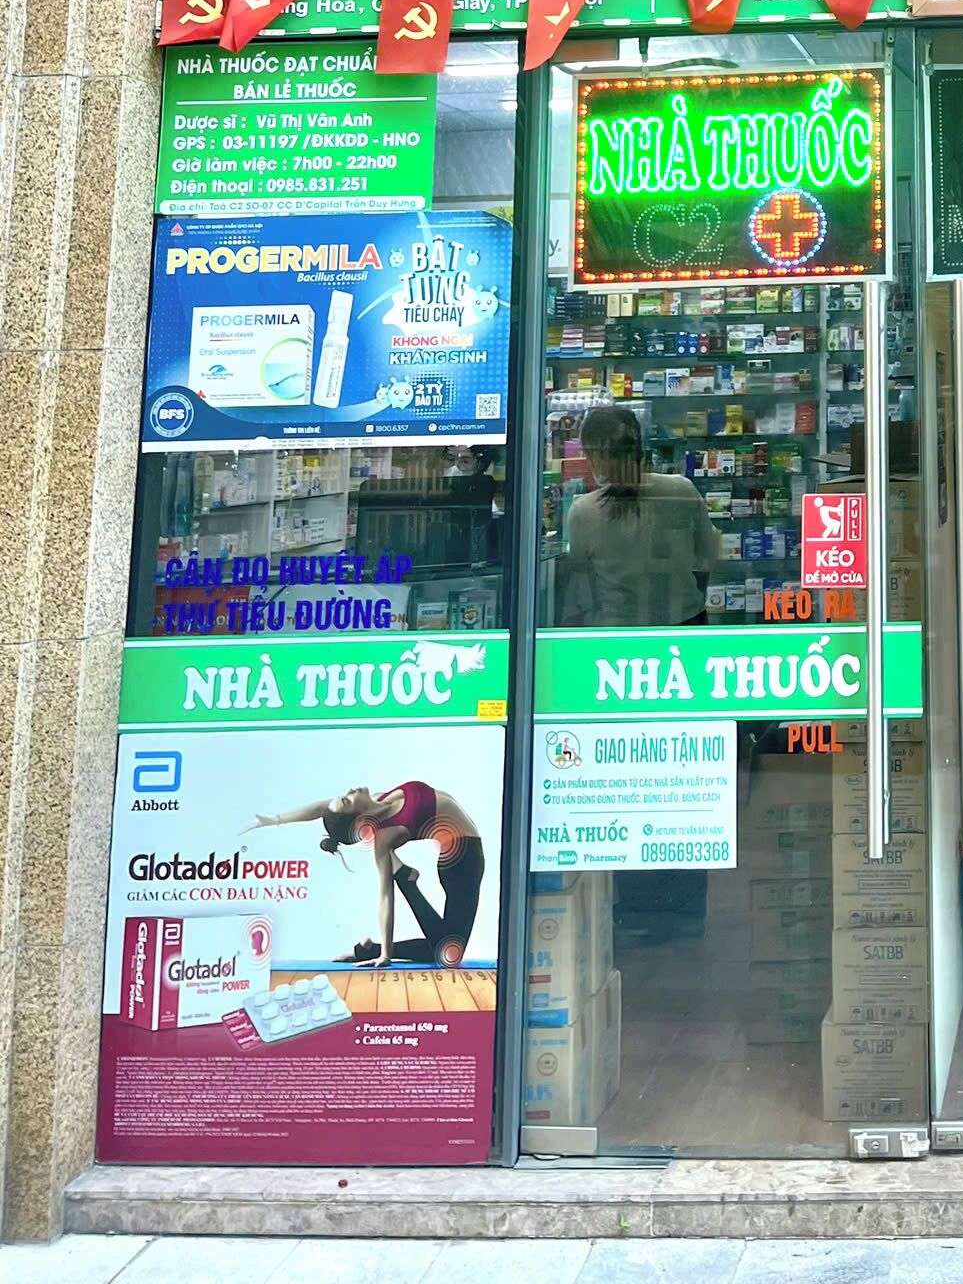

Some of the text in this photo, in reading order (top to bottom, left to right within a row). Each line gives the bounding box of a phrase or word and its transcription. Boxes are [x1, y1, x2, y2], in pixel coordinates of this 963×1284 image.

[178, 47, 376, 76] NHÀ THUỐC ĐẠT CHUẨ
[233, 75, 357, 100] BÁN LẺ THUỐC
[174, 115, 218, 133] Dược
[256, 114, 277, 128] Vũ
[281, 114, 302, 132] Thị
[342, 113, 372, 127] Anh
[173, 136, 207, 150] GPS
[222, 135, 297, 149] 03-11197
[383, 132, 420, 147] HNO
[588, 77, 872, 195] NHÀ THUỐC
[172, 155, 397, 175] Giờ làm việc 7h00 22h00
[170, 177, 368, 196] Điện thoại 0985.831.251
[633, 203, 724, 267] C2
[166, 243, 383, 275] PROGERMILA
[411, 234, 464, 275] BẬT
[297, 272, 335, 283] Bacillus
[200, 314, 300, 326] PROGERMILA
[404, 304, 429, 323] TIÊU
[389, 348, 487, 365] KHÁNG SINH
[159, 409, 185, 419] BFS
[816, 546, 854, 567] KÉO
[165, 550, 223, 587] CÂN
[806, 570, 863, 583] ĐỂ MỞ CỬA
[294, 590, 392, 632] ĐƯỜNG
[764, 582, 856, 620] KÉO RA
[595, 634, 861, 701] NHÀ THUỐC
[183, 652, 284, 711] NHÀ
[787, 723, 843, 754] PULL
[595, 732, 725, 767] GIAO HÀNG TẬN NƠI
[131, 799, 180, 811] Abbott
[538, 819, 628, 843] NHÀ THUỐC
[641, 841, 729, 862] 0896693368
[129, 851, 309, 881] Glotadol POWER
[127, 886, 307, 902] GIẢM CÁC CƠN ĐAU NẶNG
[864, 946, 904, 960] SATBB
[168, 955, 236, 982] Glotadol
[222, 980, 250, 992] POWER
[363, 1023, 448, 1033] Paracetamol 650 mg
[363, 1036, 418, 1046] Cafein 65 mg
